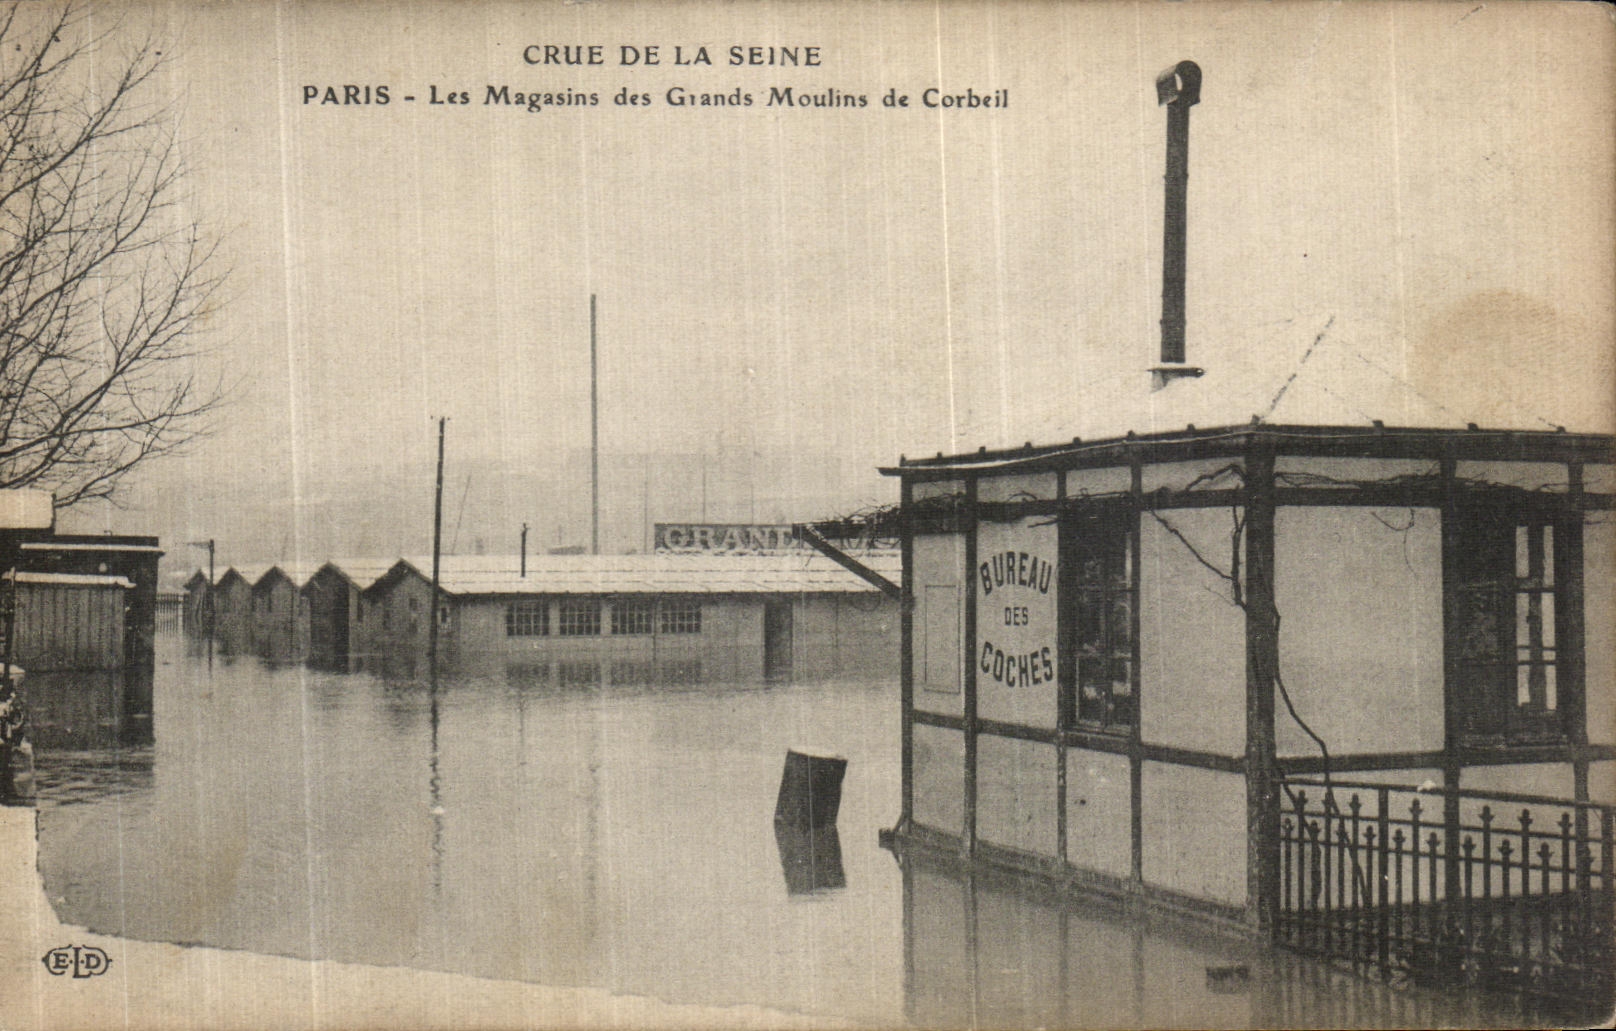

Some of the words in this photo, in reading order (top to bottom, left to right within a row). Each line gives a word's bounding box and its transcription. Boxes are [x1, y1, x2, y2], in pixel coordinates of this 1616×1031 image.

[664, 526, 812, 550] GRAND
[979, 550, 1052, 597] BUREAU
[1004, 606, 1029, 627] DES
[980, 640, 1054, 688] COCHES
